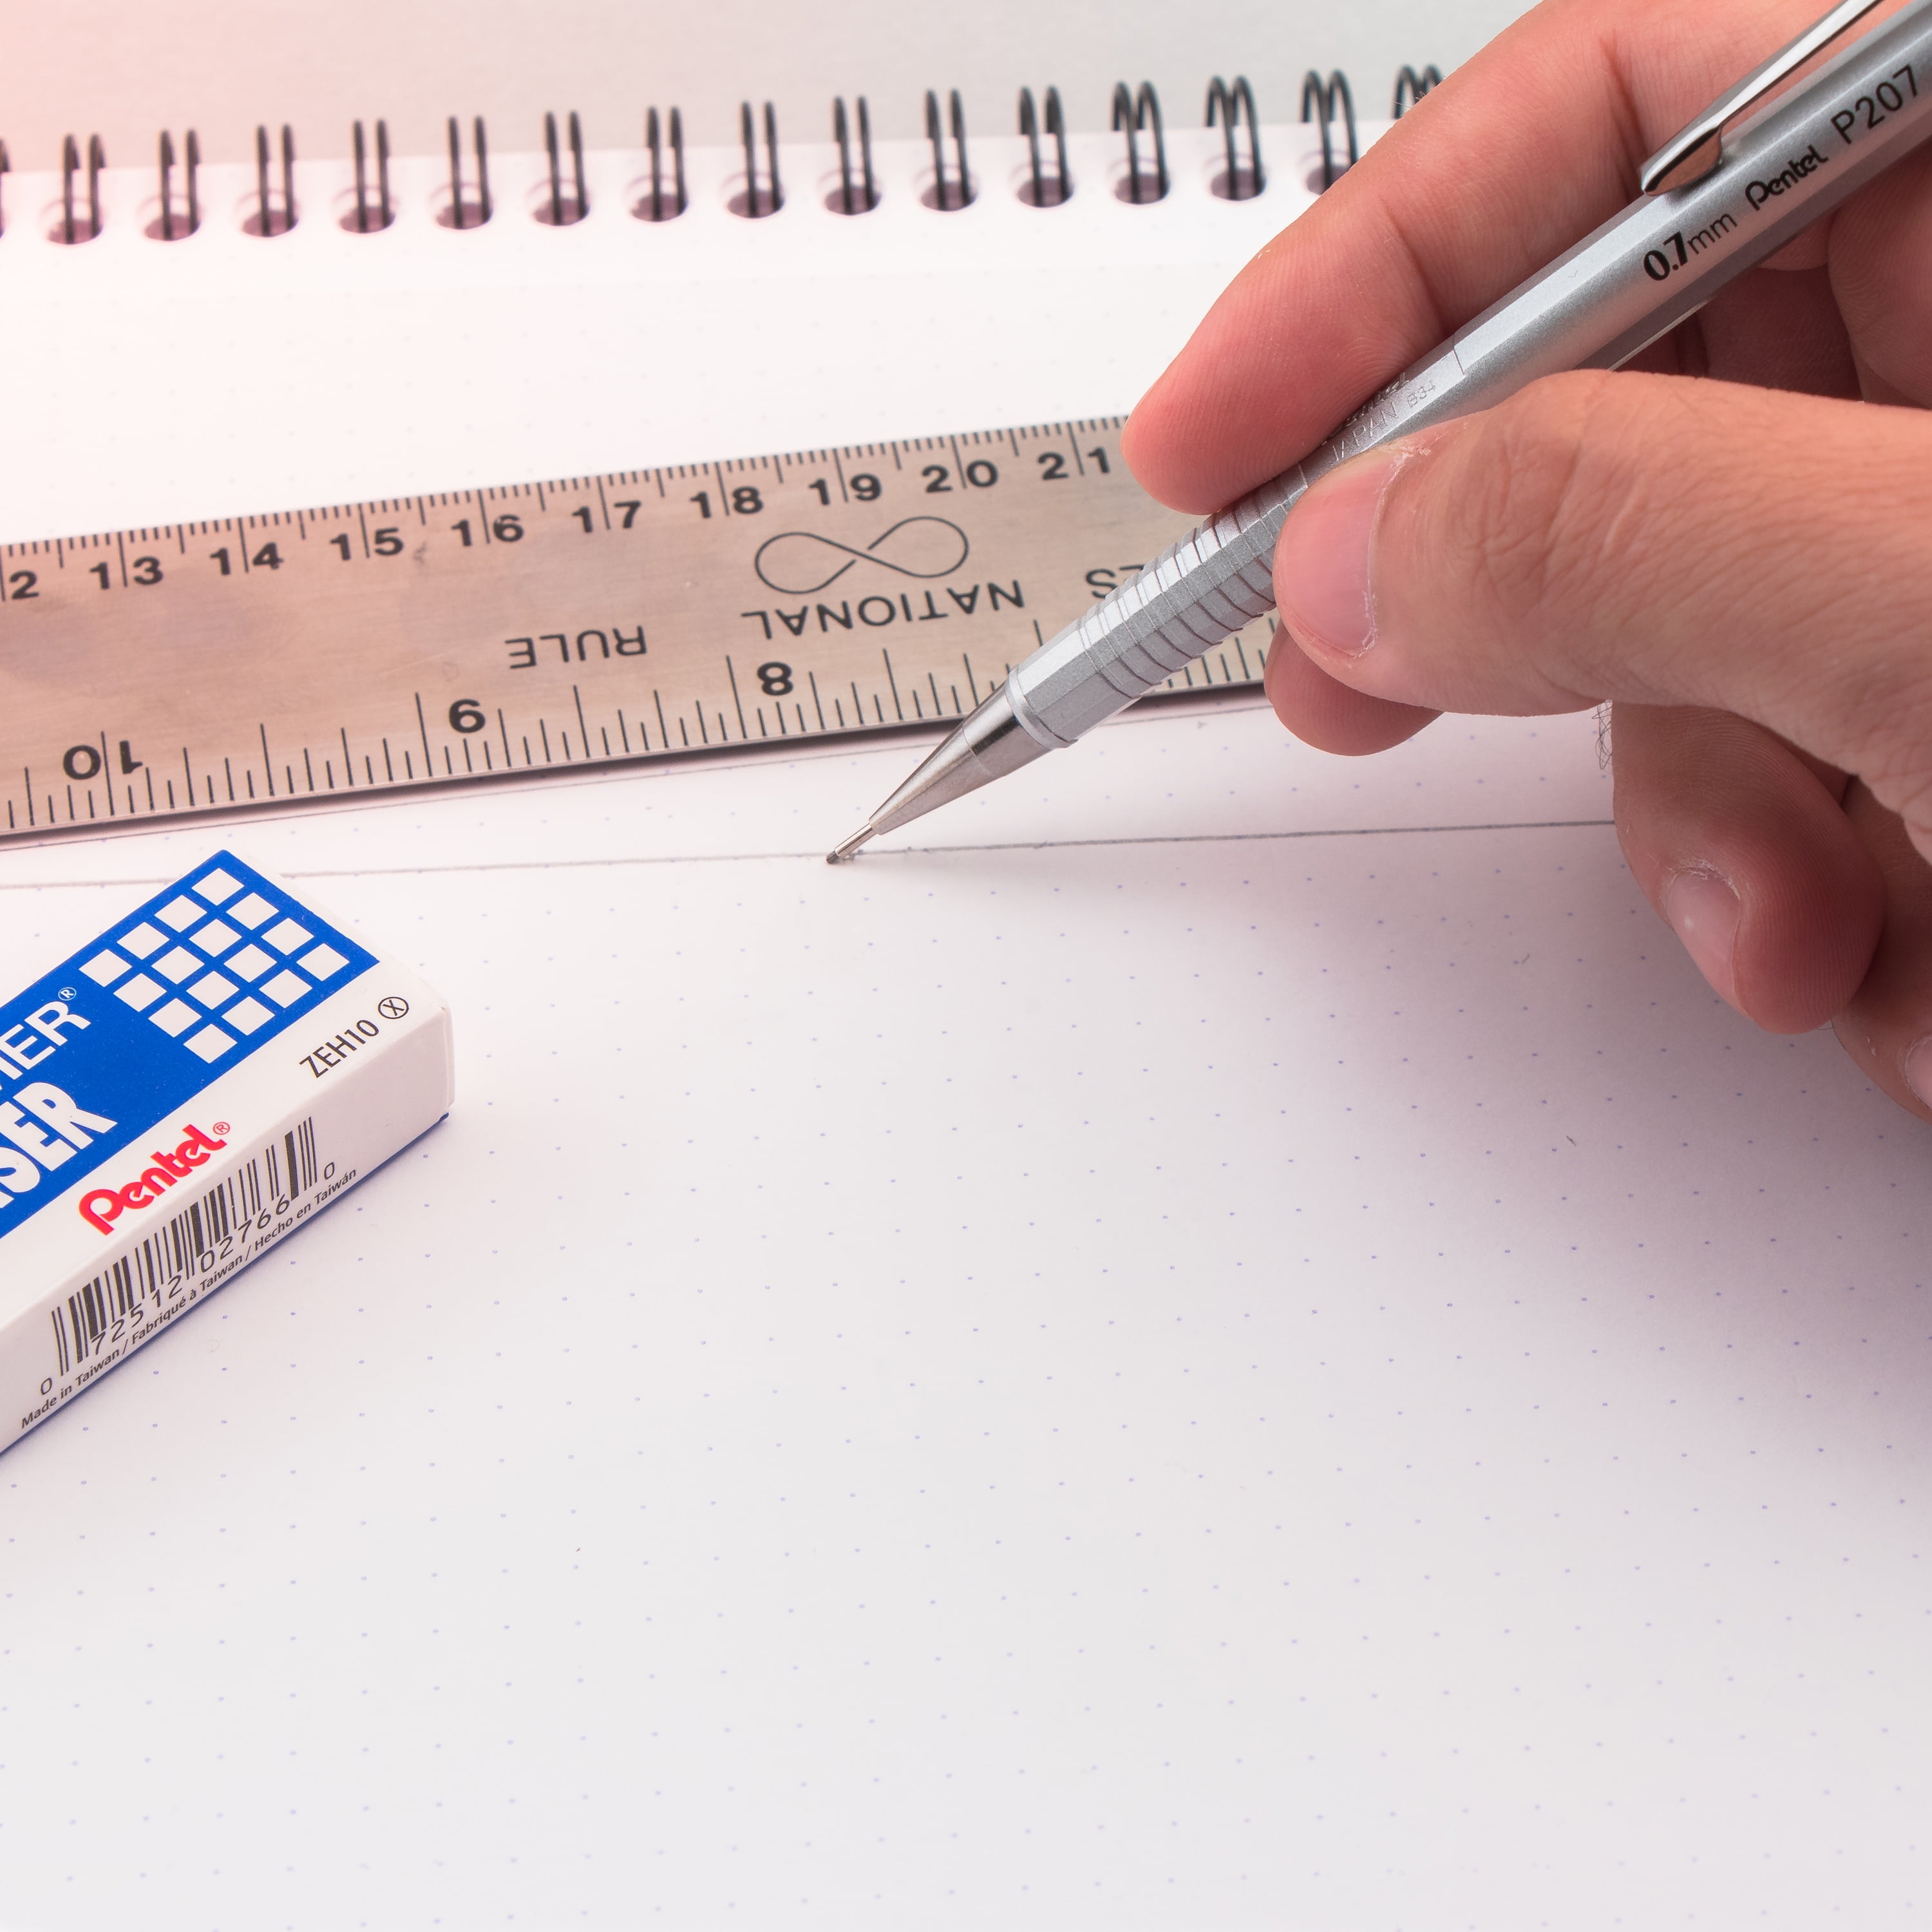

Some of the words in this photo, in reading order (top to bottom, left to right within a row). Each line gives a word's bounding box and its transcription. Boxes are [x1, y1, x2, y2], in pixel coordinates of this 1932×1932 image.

[1643, 213, 1738, 281] 0.7mm
[1744, 145, 1829, 211] Pentel
[1830, 64, 1920, 145] P207
[1330, 401, 1399, 466] JAPAN
[8, 569, 40, 600] 2
[89, 555, 164, 589] 13
[209, 542, 284, 576] 14
[330, 527, 404, 561] 15
[451, 514, 524, 546] 16
[572, 500, 641, 533] 17
[689, 486, 764, 519] 18
[808, 473, 882, 506] 19
[921, 459, 999, 493] 20
[1037, 447, 1111, 481] 21
[741, 580, 1025, 640] NATIONAL
[504, 625, 647, 670] RULE
[756, 661, 794, 696] 8
[299, 1019, 379, 1078] ZEH10
[21, 1396, 57, 1429] Made
[61, 1385, 72, 1399] in
[75, 1348, 120, 1386] Taiwan
[131, 1296, 187, 1345] Fabriqué
[200, 1254, 243, 1292] Taiwan
[255, 1217, 294, 1251] Hecho
[296, 1204, 311, 1219] en
[314, 1169, 357, 1205] Taiwán
[40, 1376, 53, 1396] 0
[91, 1274, 182, 1356] 72512
[200, 1193, 290, 1273] 02766
[323, 1161, 336, 1180] 0
